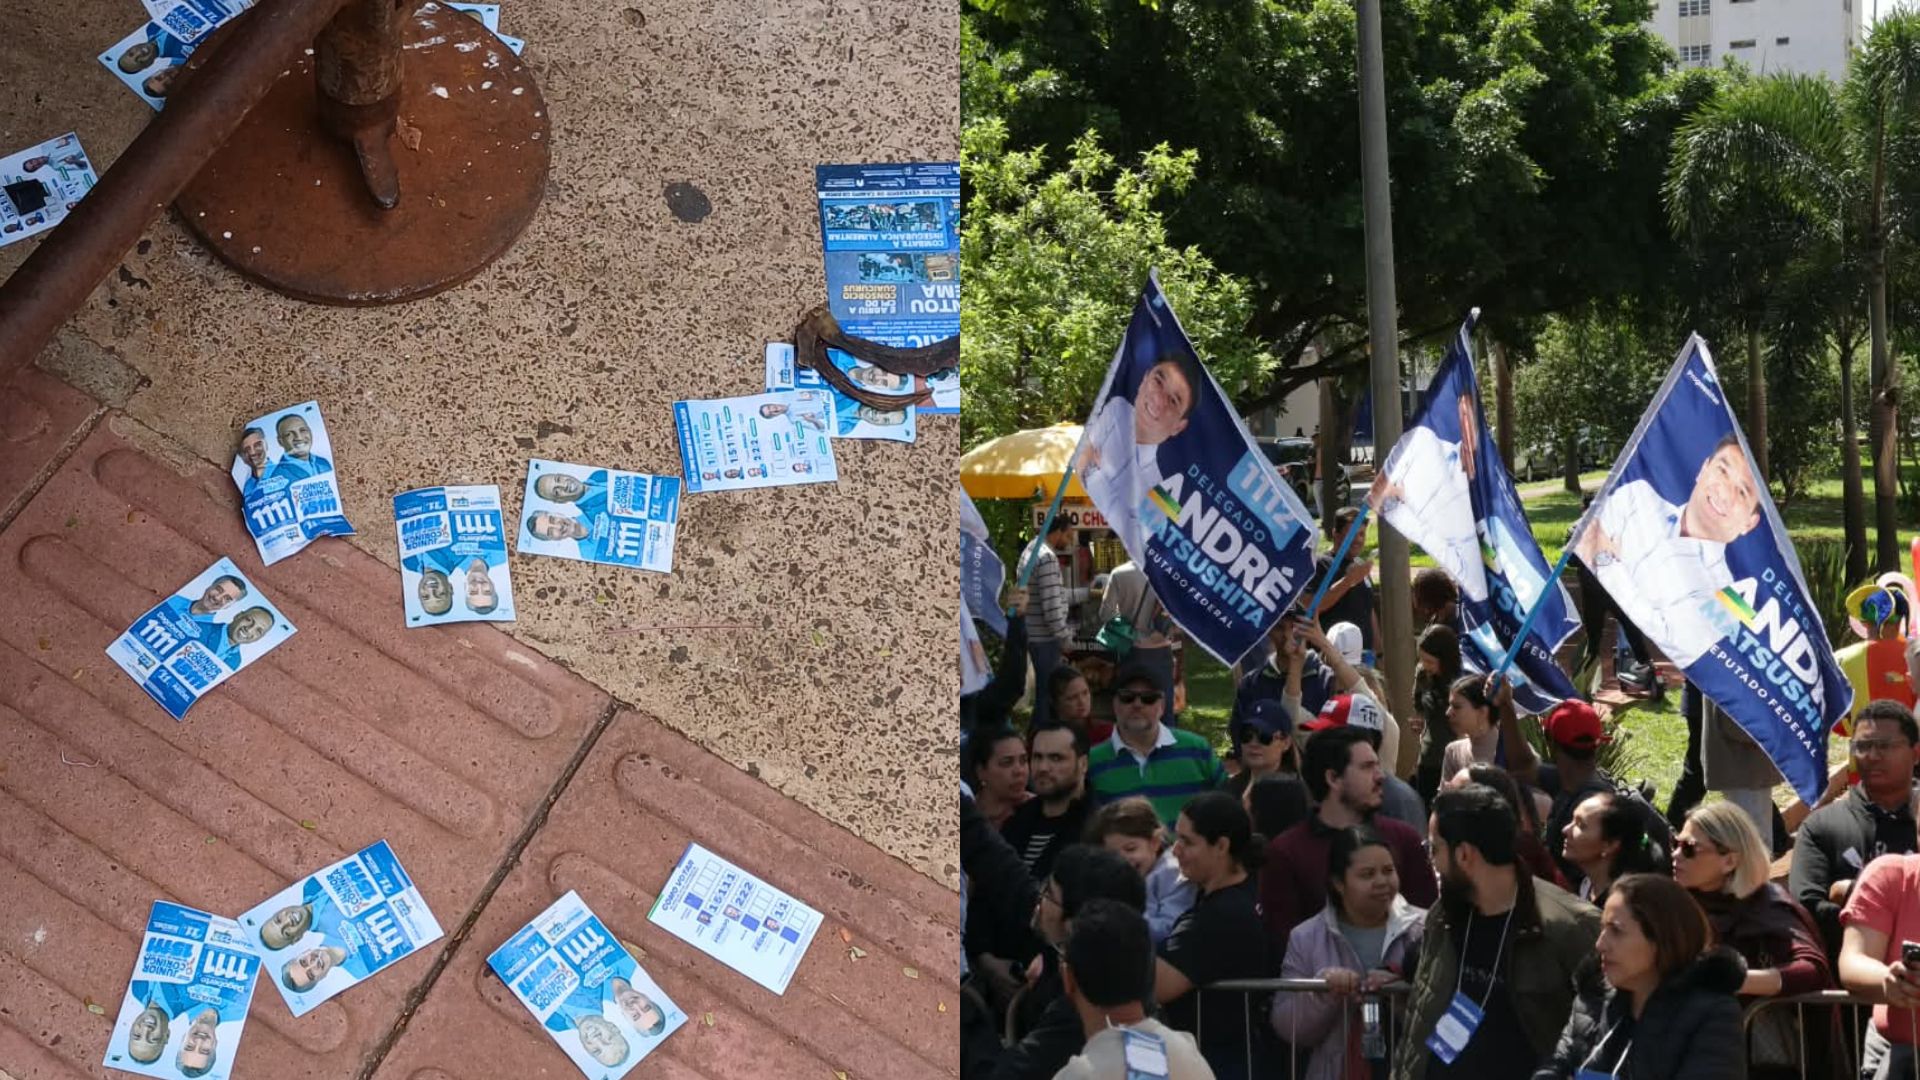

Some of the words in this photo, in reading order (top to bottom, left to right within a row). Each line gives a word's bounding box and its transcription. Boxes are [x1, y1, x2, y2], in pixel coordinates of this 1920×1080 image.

[251, 497, 296, 530] 1111
[455, 510, 496, 535] 1111
[1188, 464, 1266, 542] DELEGADO
[615, 521, 641, 560] 1111
[1152, 473, 1294, 613] ANDRÉ
[1148, 545, 1188, 588] PUTADO
[1188, 587, 1233, 629] FEDERAL
[134, 616, 179, 655] 1111
[1709, 644, 1768, 699] EPUTADO
[1768, 698, 1818, 759] FEDERAL
[325, 872, 349, 904] JUNIOR
[660, 885, 680, 912] COMO
[674, 858, 695, 887] VOTAR
[734, 880, 753, 906] 222
[363, 907, 407, 956] 1111
[560, 922, 608, 966] 1111
[142, 964, 178, 977] JUNIOR
[202, 949, 248, 980] 1111
[535, 981, 568, 1011] JUNIOR
